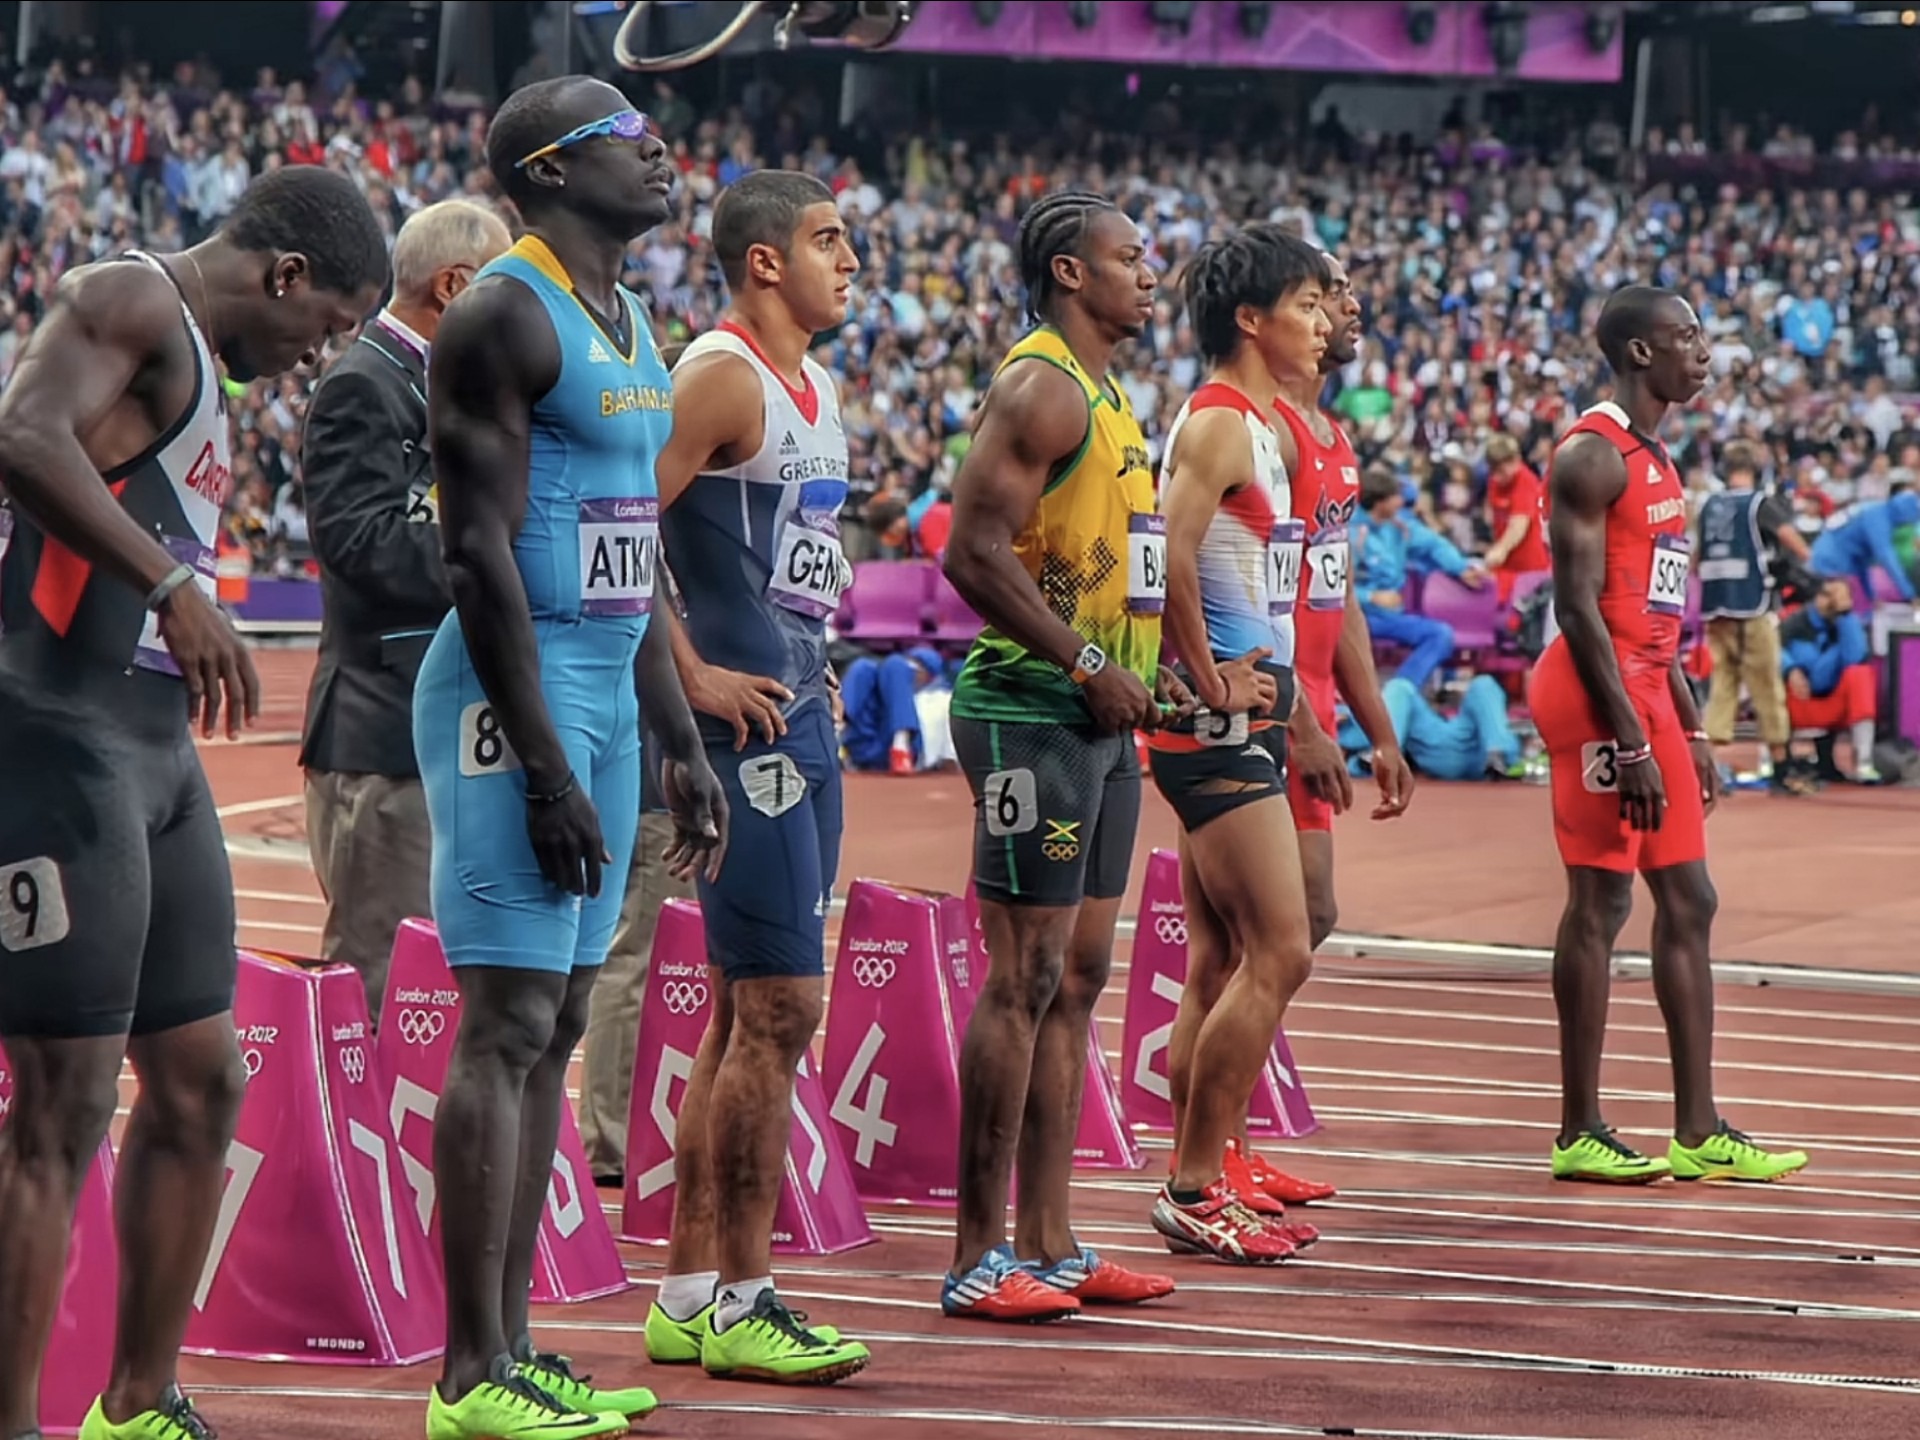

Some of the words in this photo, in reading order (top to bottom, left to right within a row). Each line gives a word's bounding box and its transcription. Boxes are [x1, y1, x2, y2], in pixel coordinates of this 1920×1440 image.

[779, 456, 822, 481] GREAT
[474, 707, 502, 767] 8
[757, 760, 783, 808] 7
[1596, 745, 1617, 787] 3
[998, 777, 1019, 828] 6
[10, 870, 39, 938] 9
[883, 939, 908, 955] 2012
[395, 986, 430, 1003] London
[431, 989, 460, 1007] 2012
[247, 1024, 279, 1044] 2012
[829, 1021, 898, 1168] 4
[193, 1139, 265, 1313] 7
[349, 1117, 407, 1300] 7
[318, 1337, 366, 1350] MONDO
